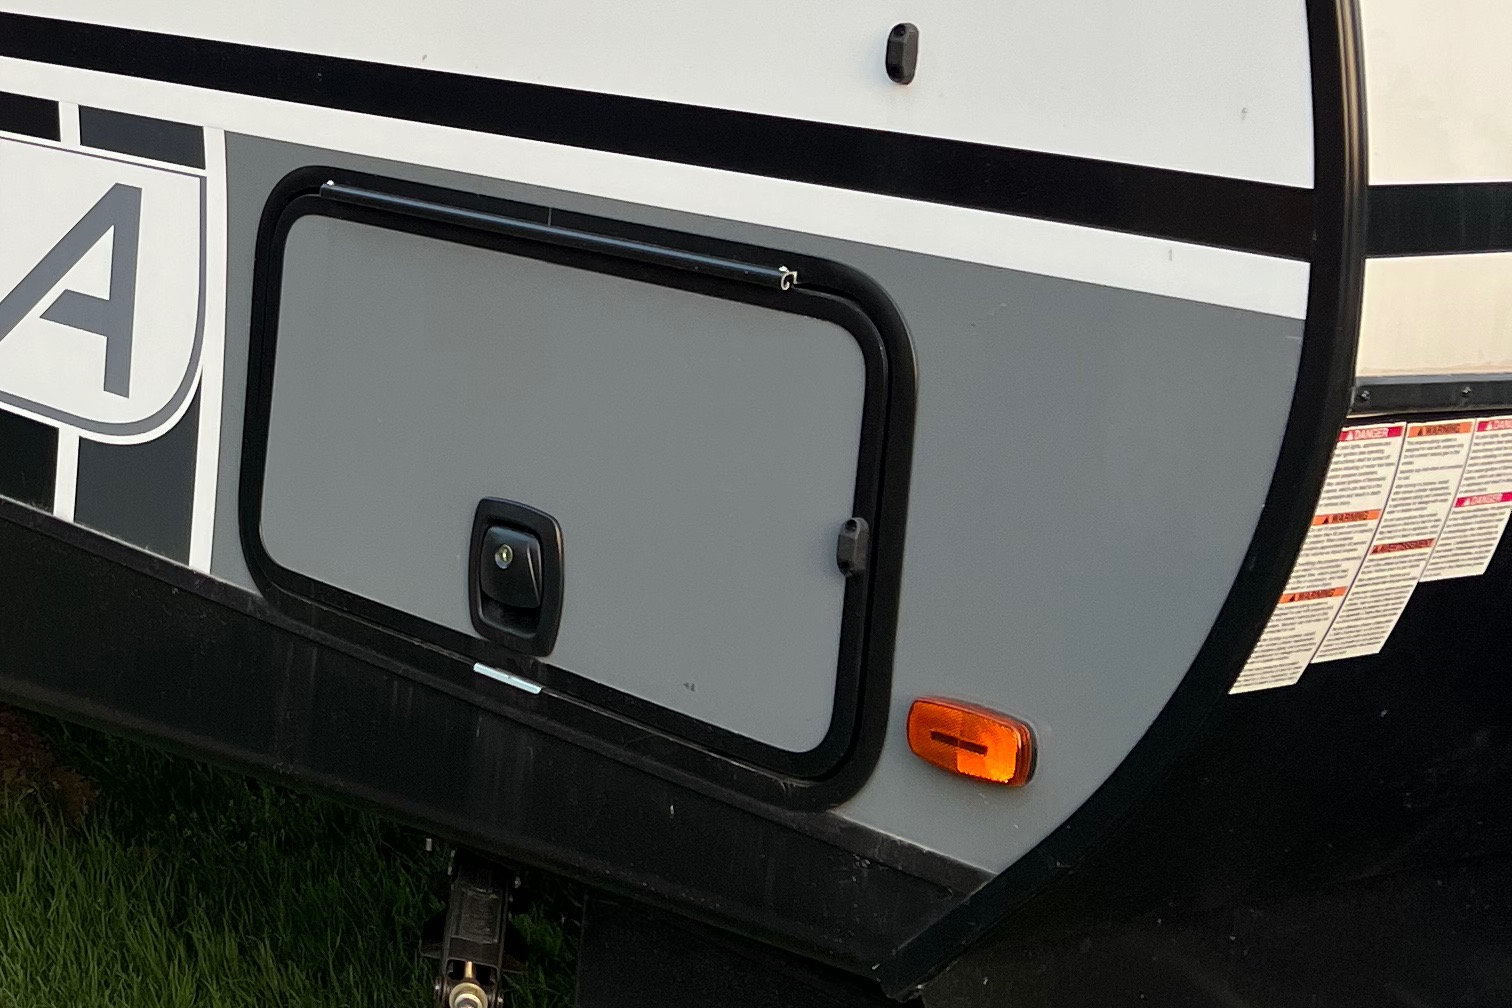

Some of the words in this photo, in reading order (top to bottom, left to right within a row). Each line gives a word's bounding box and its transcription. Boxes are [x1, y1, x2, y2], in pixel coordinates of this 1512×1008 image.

[1354, 428, 1389, 440] DANGER
[1426, 423, 1461, 436] WARNING
[1471, 493, 1503, 505] DANGER
[1331, 511, 1369, 524] WARNING
